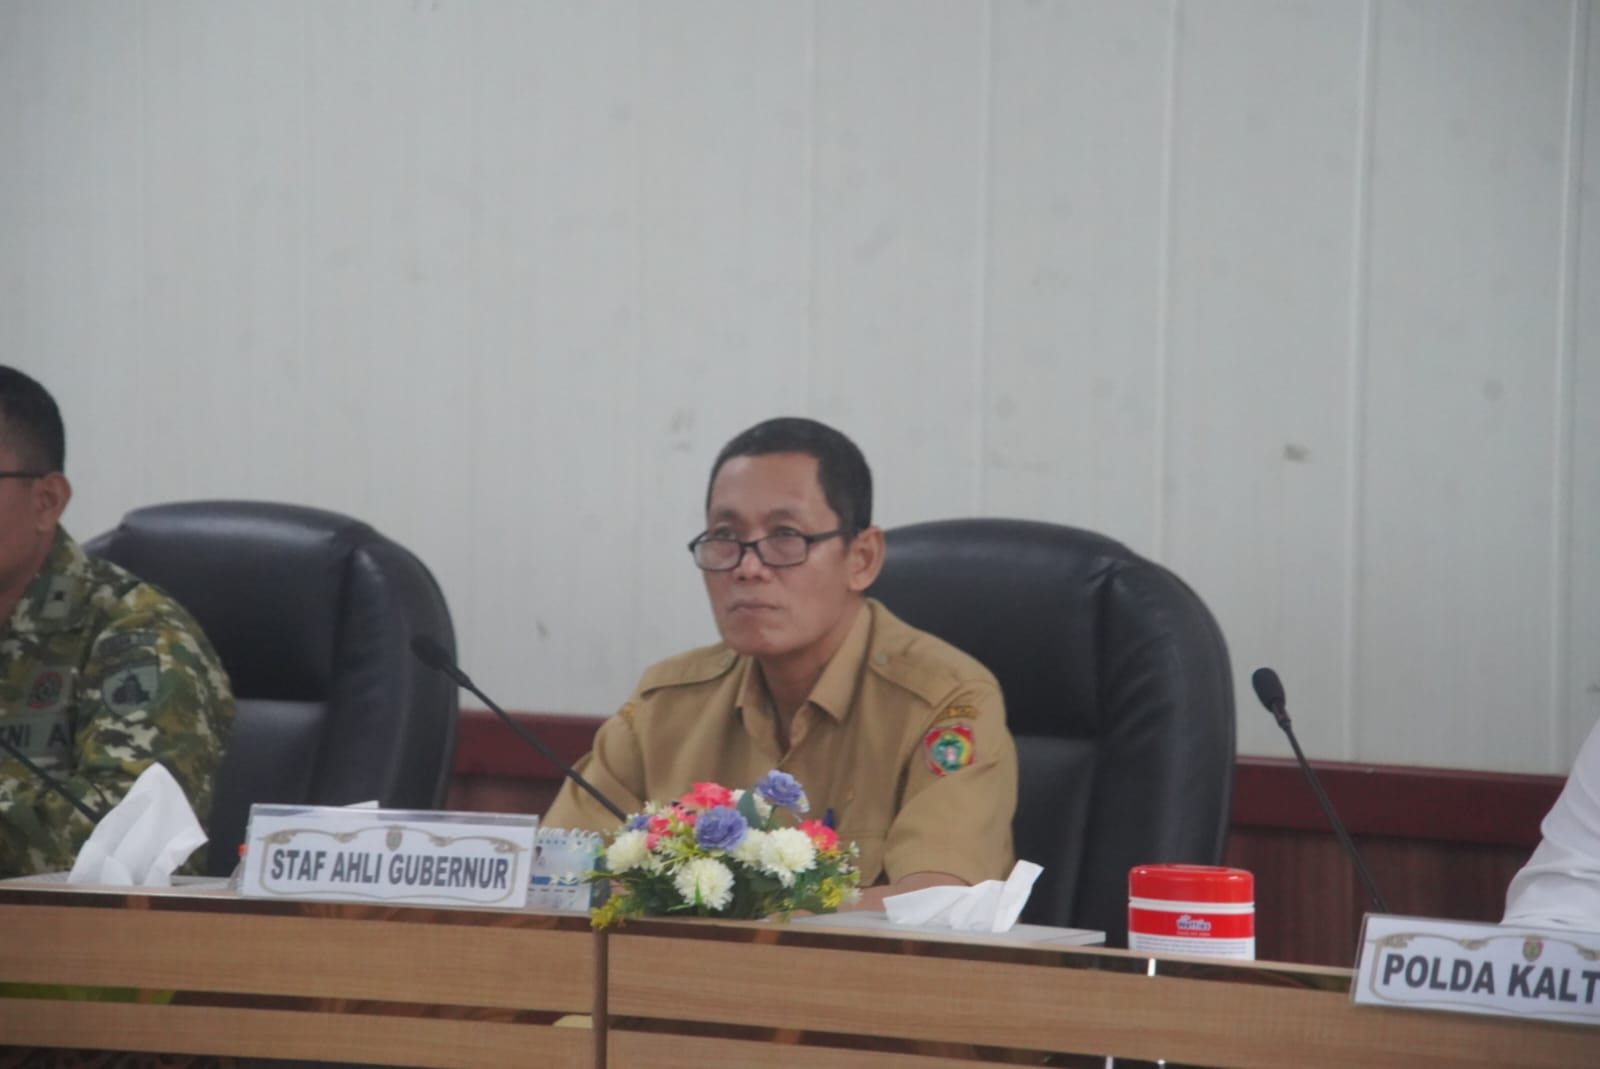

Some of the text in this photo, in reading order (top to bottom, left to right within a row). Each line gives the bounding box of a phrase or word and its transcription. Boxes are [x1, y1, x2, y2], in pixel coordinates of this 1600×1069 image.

[271, 849, 508, 889] STAF AHLI GUBERNUR
[1382, 953, 1600, 1005] POLDA KALT
